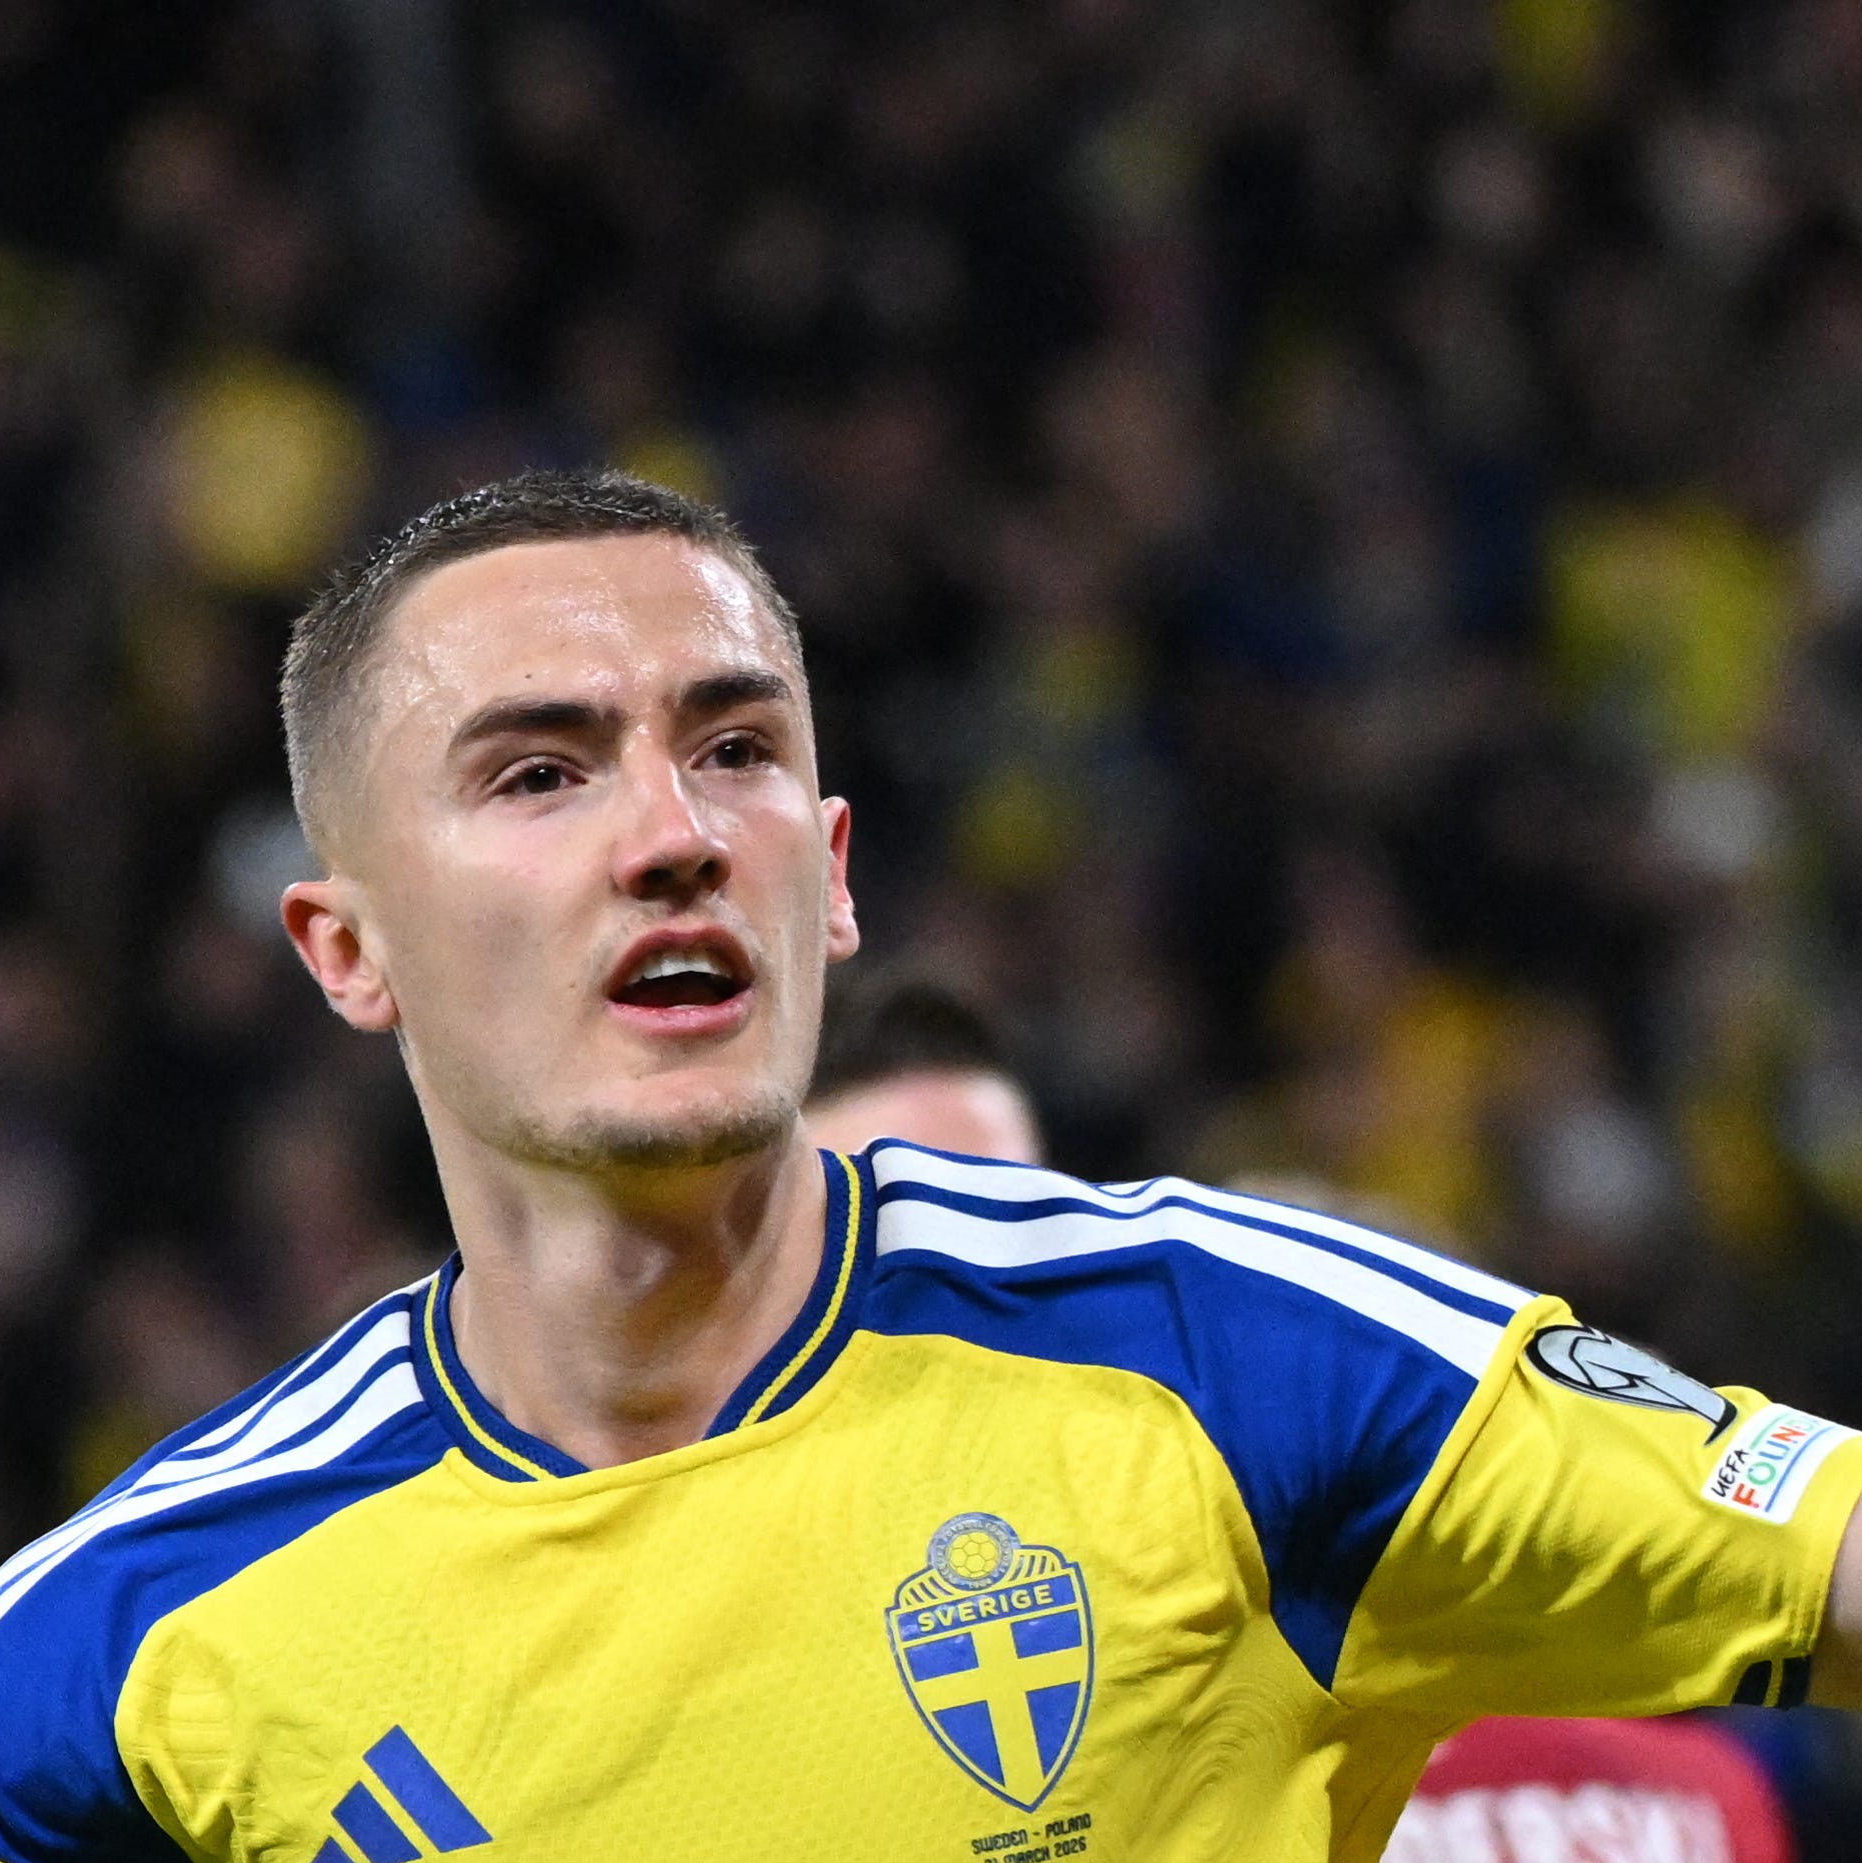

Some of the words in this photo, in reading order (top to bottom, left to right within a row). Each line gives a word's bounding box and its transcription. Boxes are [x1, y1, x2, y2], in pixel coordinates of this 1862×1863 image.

[1710, 1448, 1750, 1498] UEFA
[917, 1583, 1055, 1634] SVERIGE
[971, 1829, 1029, 1855] SWEDEN
[1045, 1813, 1092, 1839] POLAND
[1054, 1836, 1088, 1858] 2026
